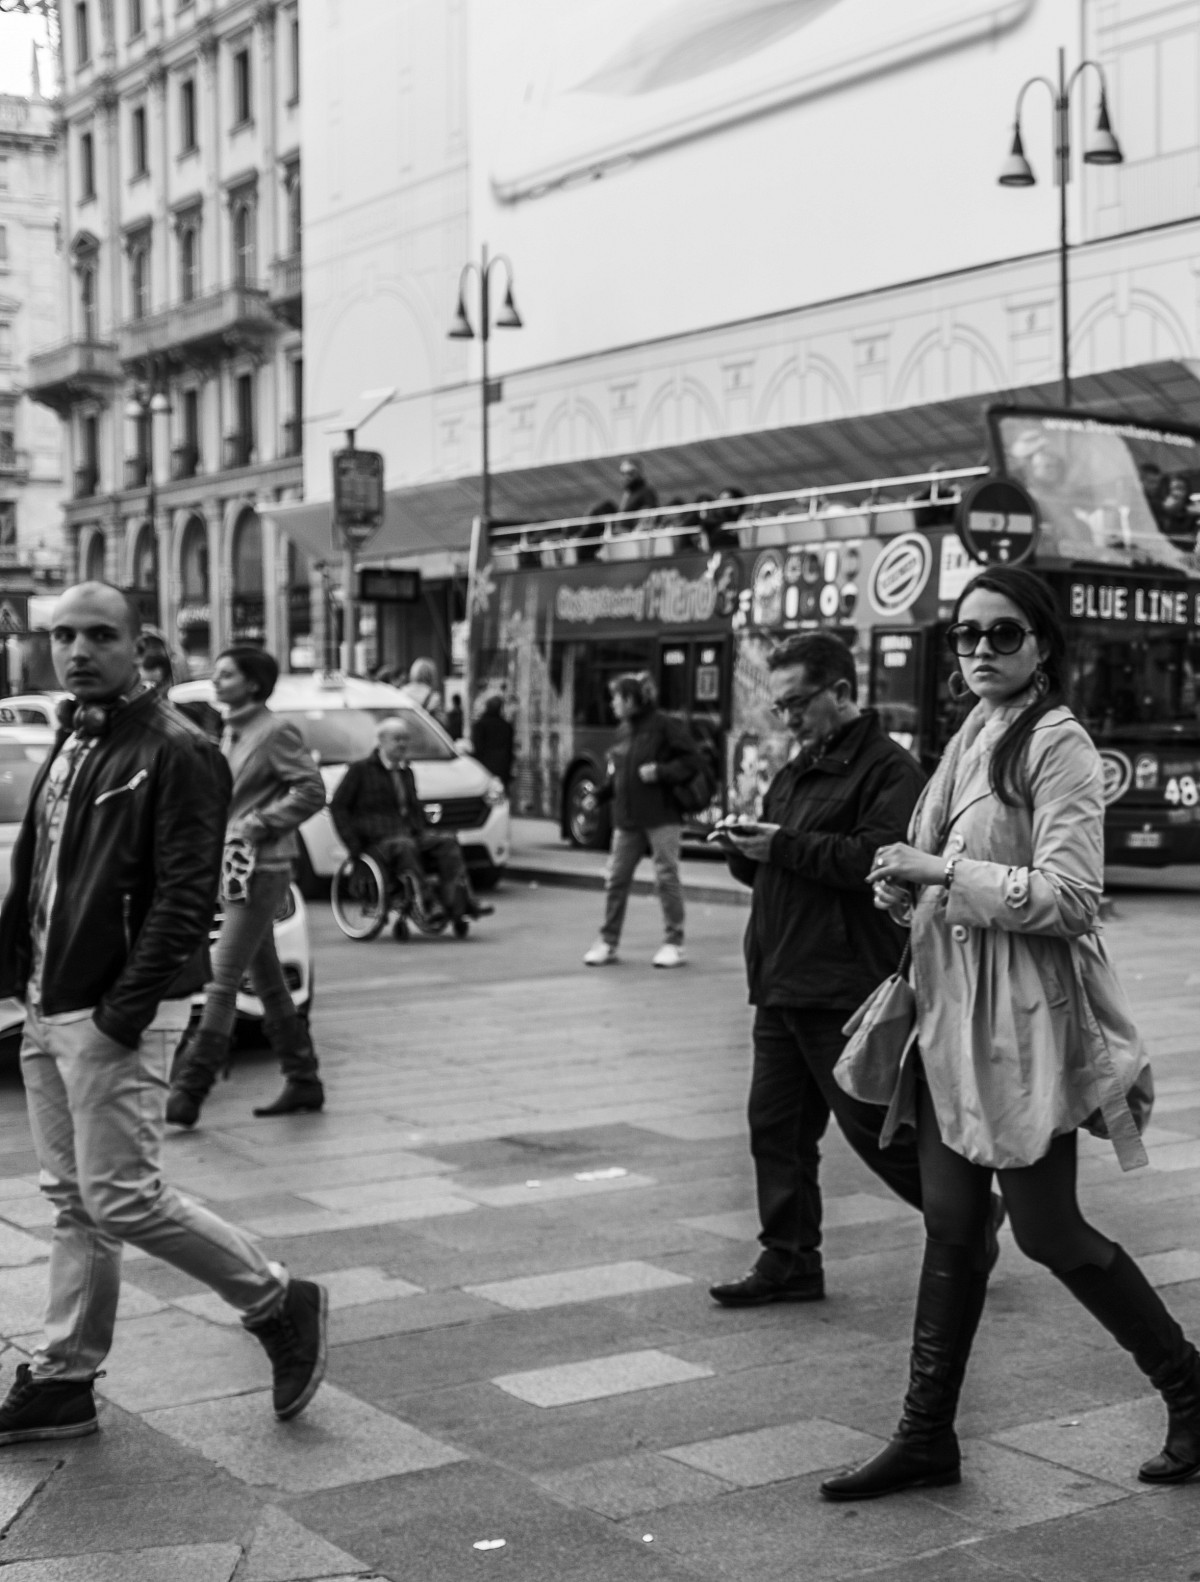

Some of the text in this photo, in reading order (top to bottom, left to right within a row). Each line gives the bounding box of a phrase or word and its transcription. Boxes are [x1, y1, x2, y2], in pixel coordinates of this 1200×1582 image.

[1070, 583, 1128, 620] BLUE
[1134, 588, 1188, 625] LINE
[1164, 775, 1199, 806] 48
